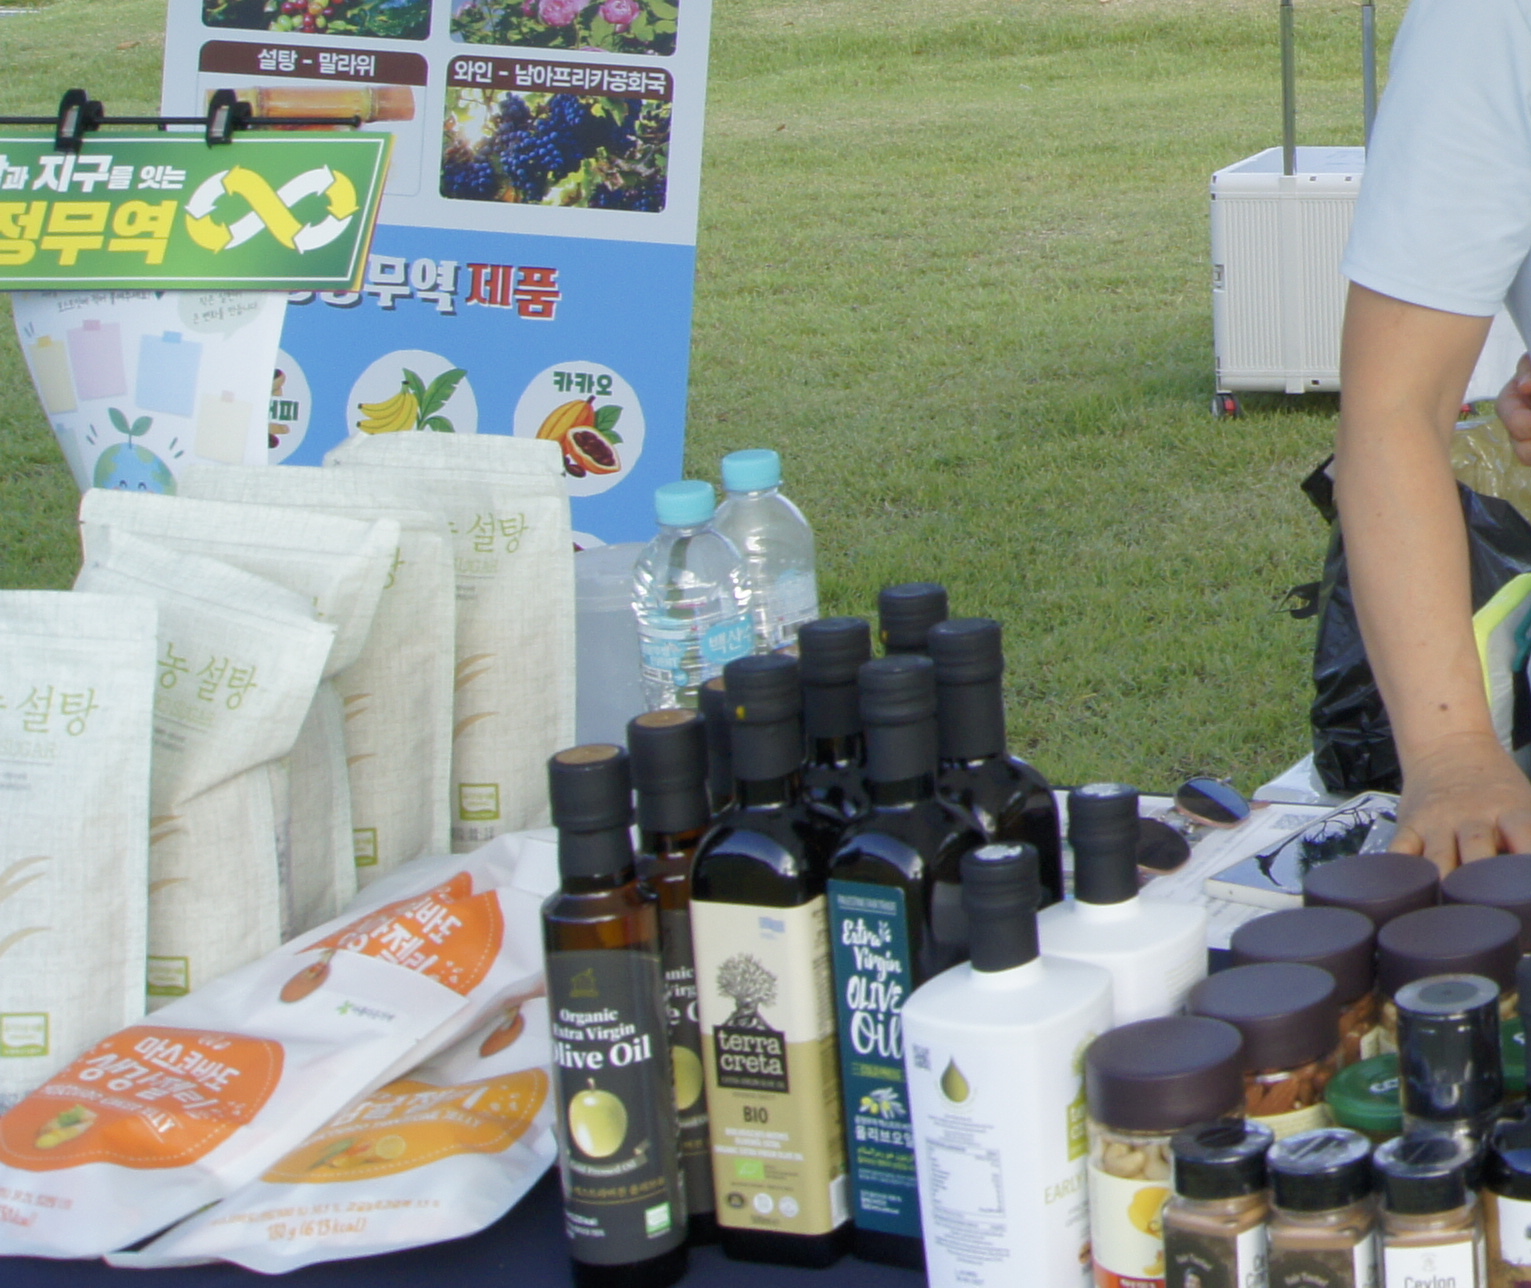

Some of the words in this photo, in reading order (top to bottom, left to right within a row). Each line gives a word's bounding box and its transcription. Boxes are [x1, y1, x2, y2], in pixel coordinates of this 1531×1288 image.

[257, 48, 299, 73] 설탕
[319, 50, 376, 77] 말라위
[454, 60, 494, 84] 와인
[514, 64, 667, 95] 남아프리카공화국
[32, 154, 133, 193] 지구를
[137, 165, 187, 191] 잇는
[464, 261, 562, 321] 제품
[552, 370, 613, 397] 카카오
[467, 512, 530, 554] 설탕
[197, 655, 258, 711] 설탕
[16, 684, 99, 737] 설탕
[558, 1007, 619, 1027] Organic
[586, 1022, 637, 1043] Virgin
[608, 1033, 653, 1068] Oil
[717, 1029, 782, 1056] terra
[719, 1052, 785, 1076] creta
[743, 1105, 769, 1124] BIO
